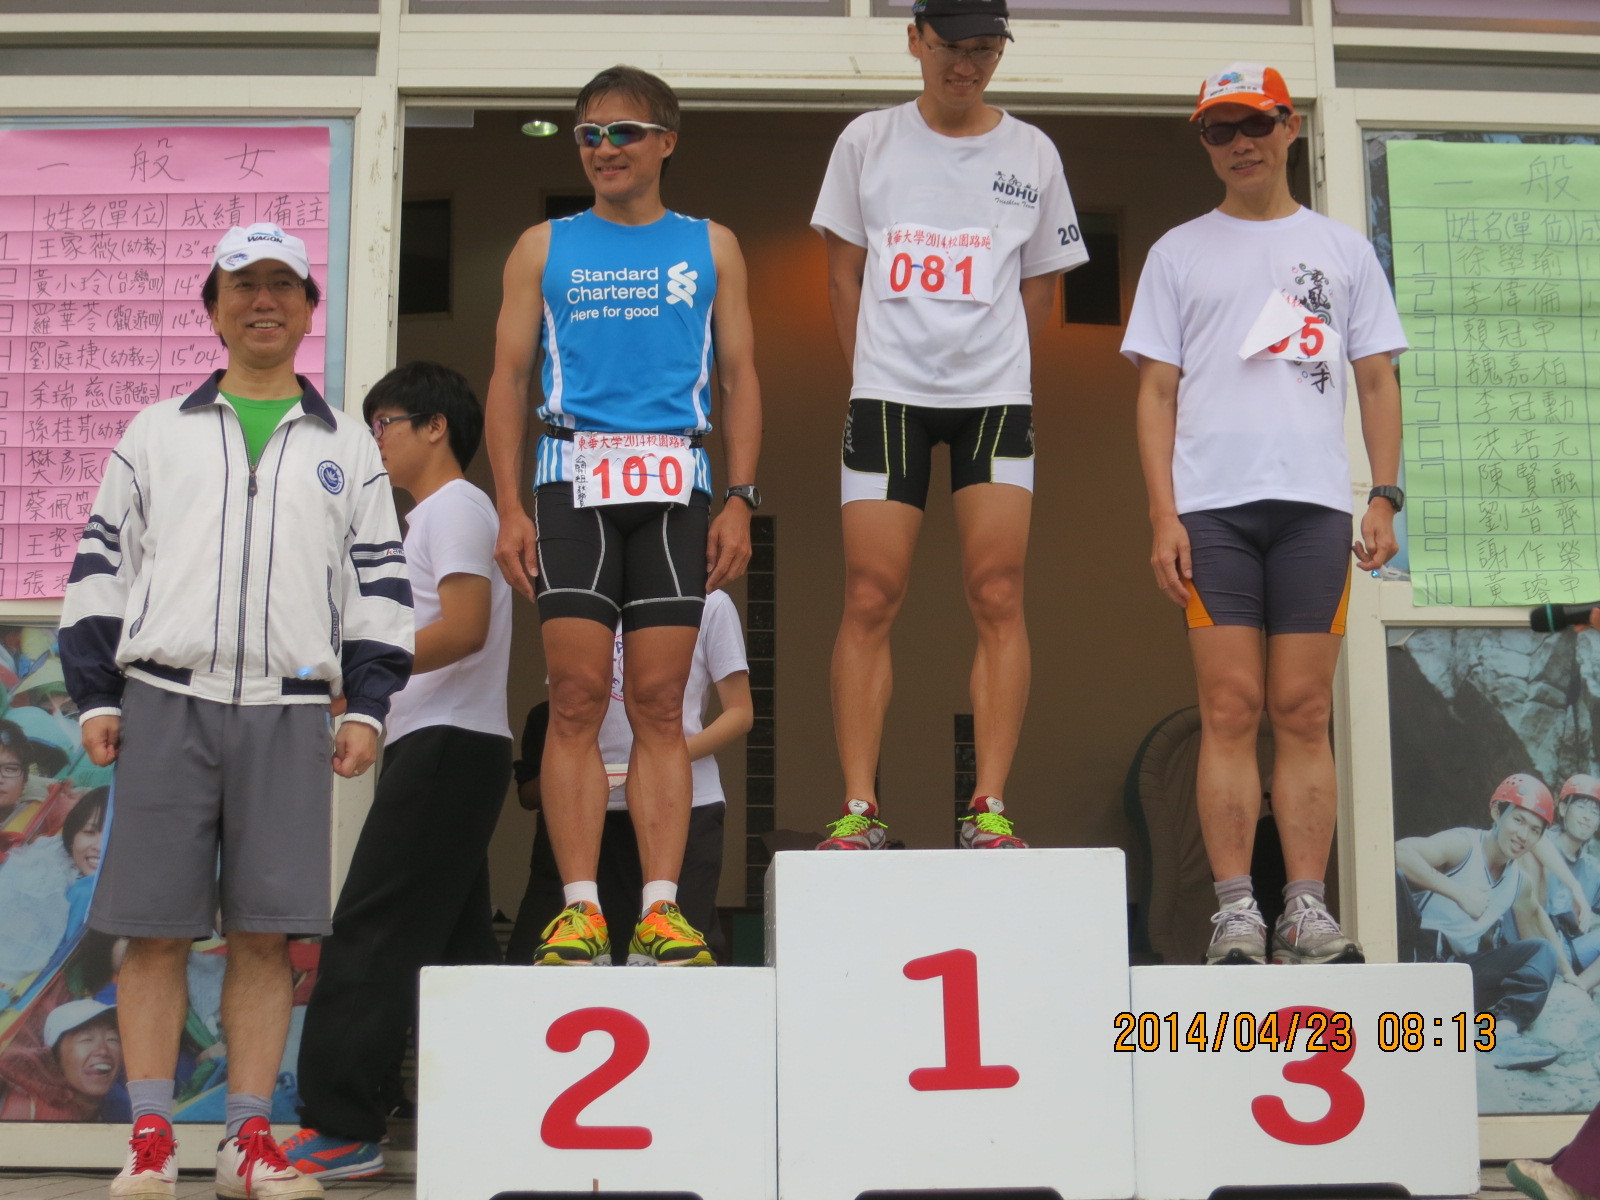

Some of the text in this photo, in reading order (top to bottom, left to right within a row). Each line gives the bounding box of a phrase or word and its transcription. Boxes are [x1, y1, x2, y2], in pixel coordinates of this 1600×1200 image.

[992, 180, 1038, 204] NDHU
[181, 195, 245, 227] 成績
[263, 194, 326, 226] 備註
[1021, 200, 1036, 210] Team
[247, 234, 283, 244] WAGON
[1057, 224, 1080, 246] 20
[571, 267, 659, 284] Standard
[567, 284, 659, 304] Chartered
[570, 305, 659, 323] Here for good
[593, 455, 683, 499] 100
[902, 948, 1020, 1091] 1
[540, 1007, 653, 1150] 2
[1251, 1005, 1365, 1146] 3
